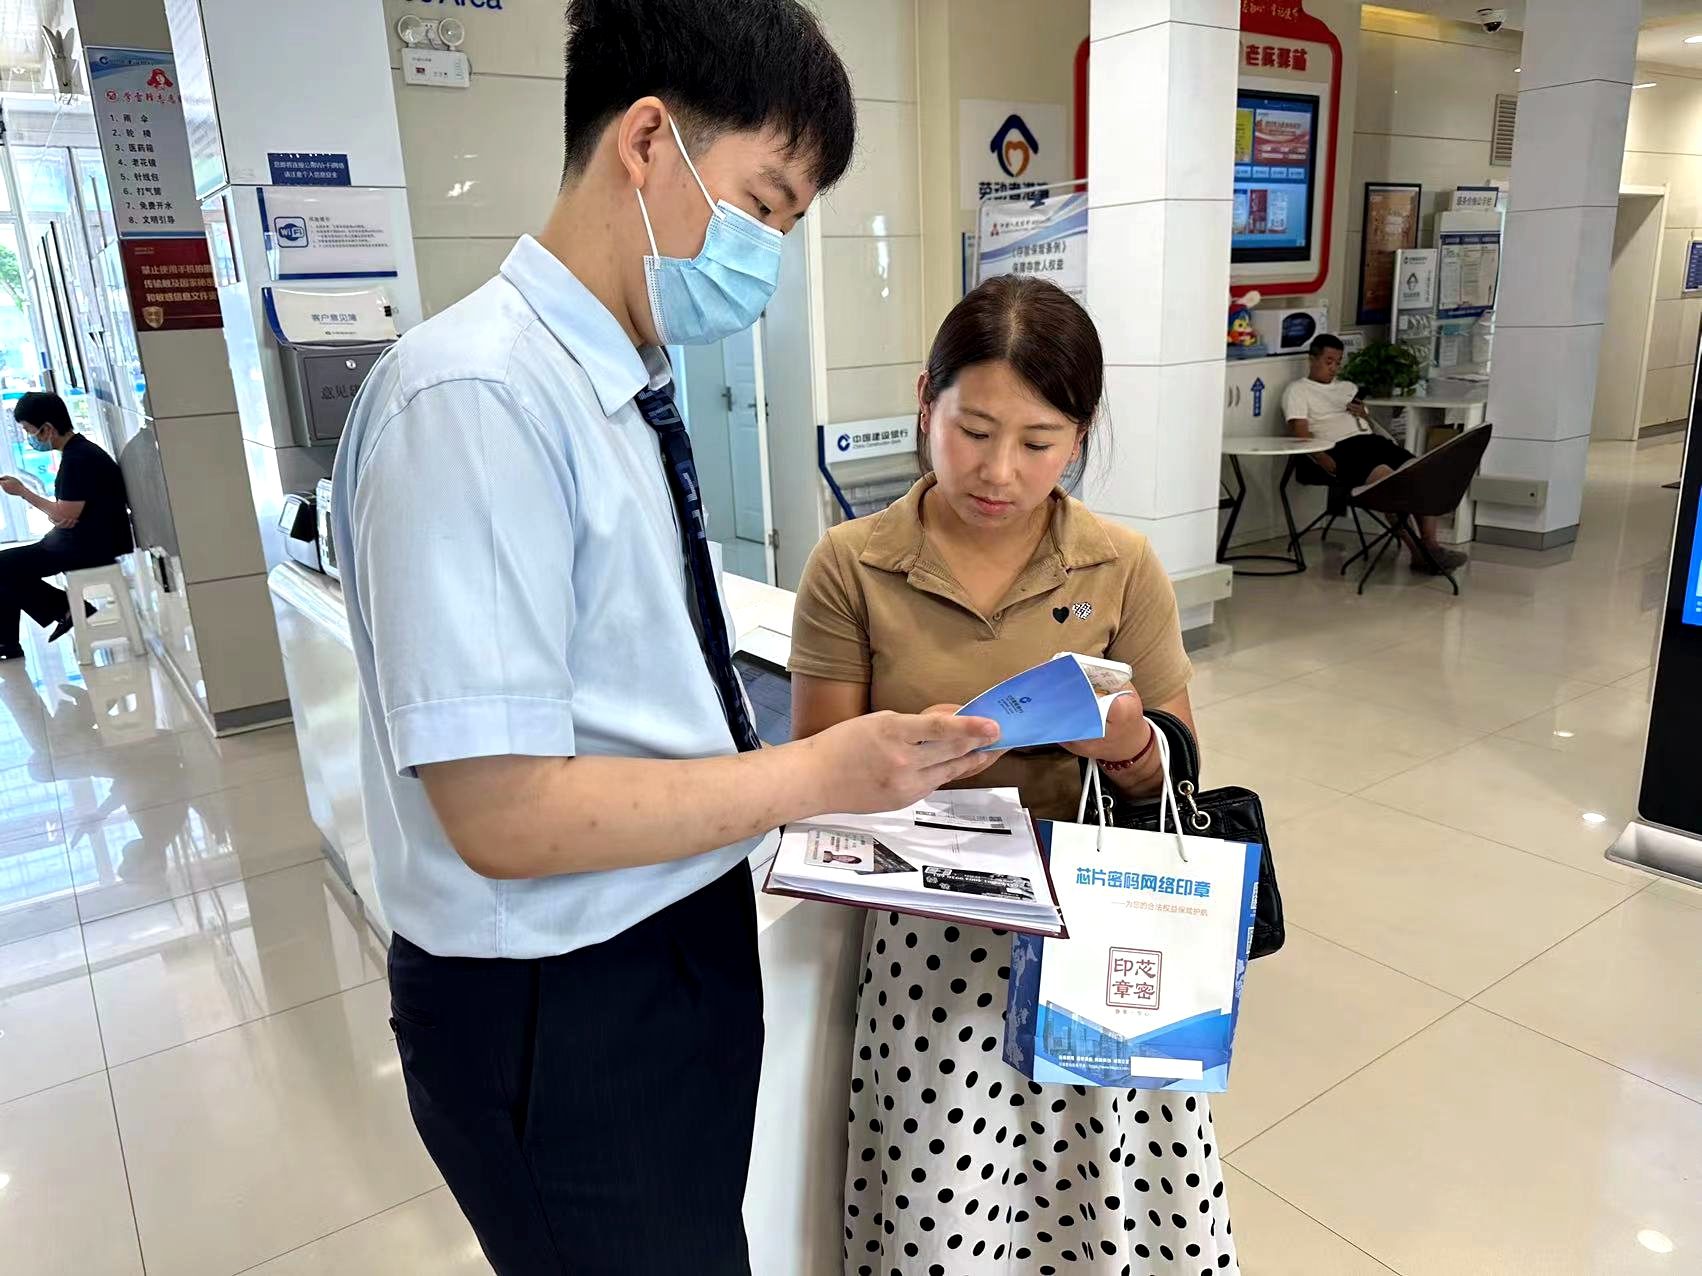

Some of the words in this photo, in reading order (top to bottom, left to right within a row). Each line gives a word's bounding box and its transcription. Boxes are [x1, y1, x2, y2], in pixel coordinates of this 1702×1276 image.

[125, 201, 173, 210] 7、免费开水
[128, 215, 175, 225] 8、文明引导
[1012, 258, 1064, 273] 保障存款人权益
[852, 429, 909, 443] 中国建设银行
[1076, 867, 1211, 898] 芯片密码网络印章
